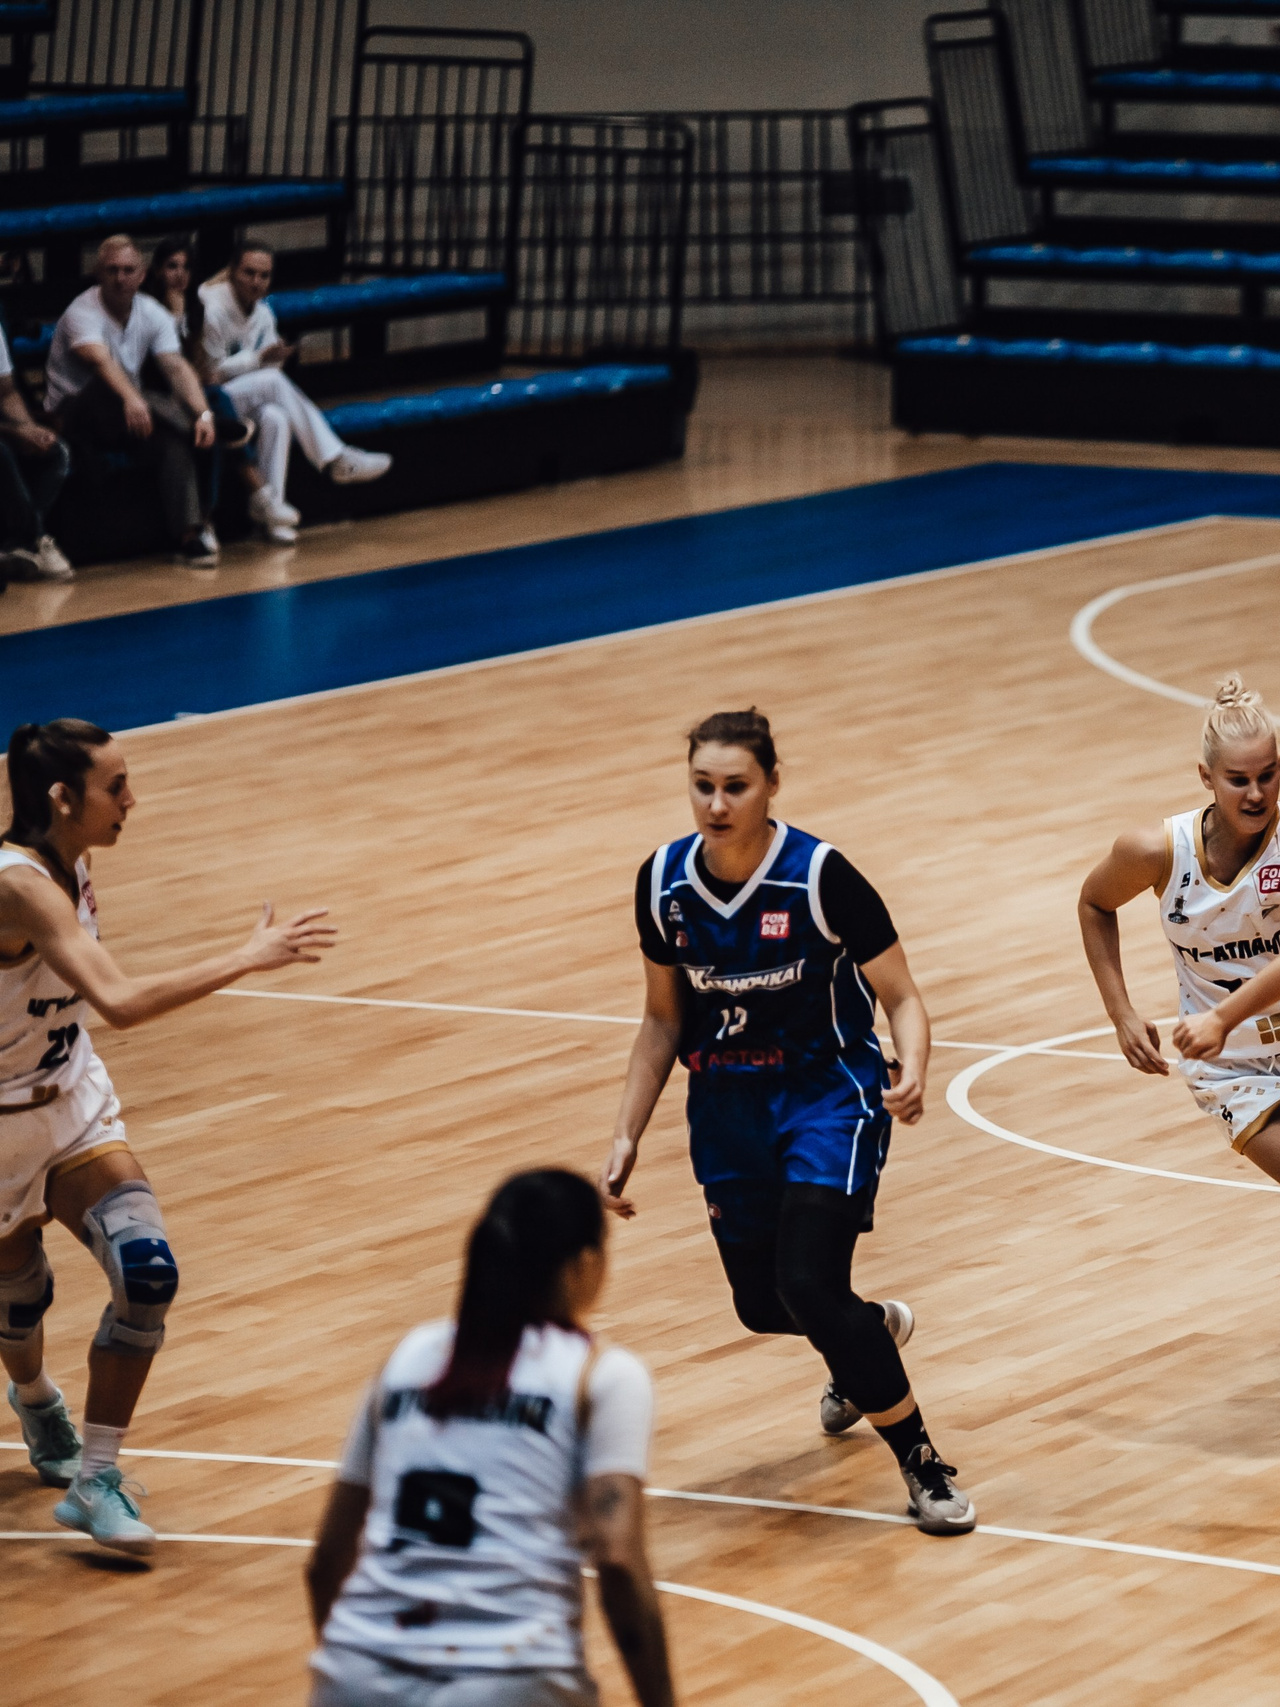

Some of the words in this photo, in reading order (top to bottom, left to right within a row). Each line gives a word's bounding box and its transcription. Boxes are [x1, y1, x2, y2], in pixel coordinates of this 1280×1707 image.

[761, 912, 789, 923] FON
[760, 924, 788, 936] BET
[715, 1005, 748, 1040] 12
